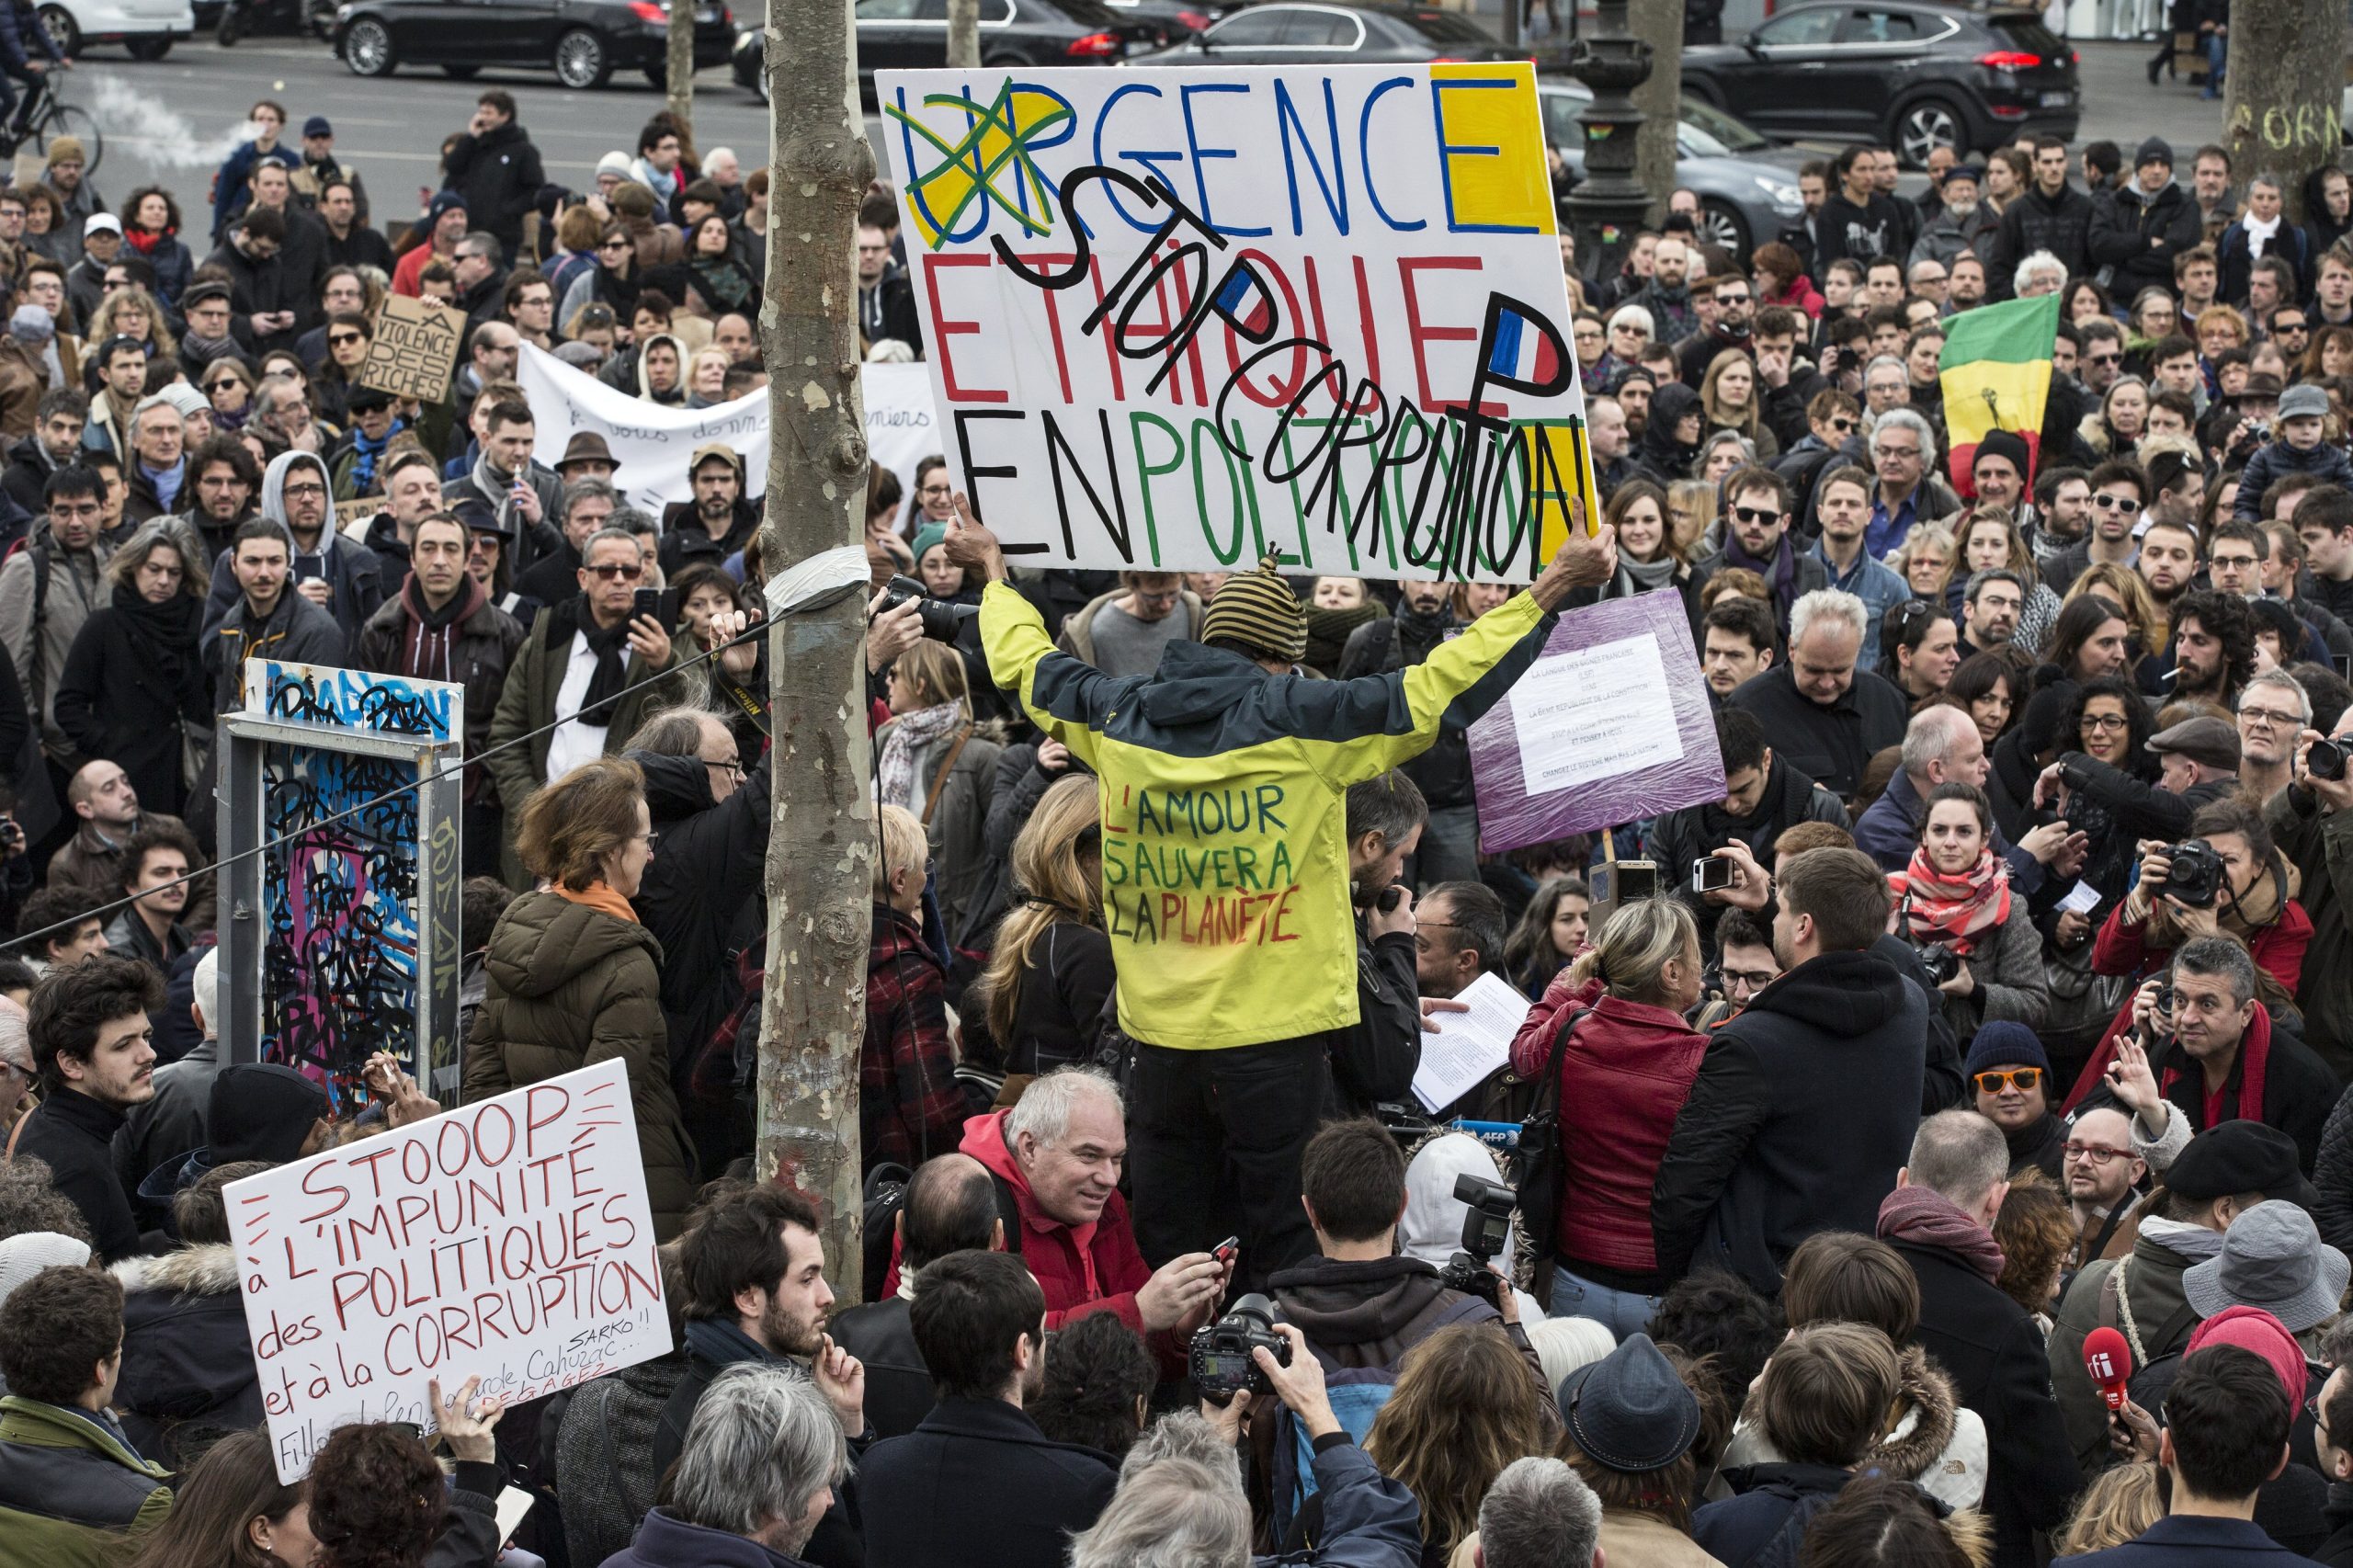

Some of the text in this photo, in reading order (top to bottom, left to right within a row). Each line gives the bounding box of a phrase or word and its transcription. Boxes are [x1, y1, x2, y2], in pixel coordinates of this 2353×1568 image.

[896, 77, 1540, 244] URGENCE
[990, 165, 1279, 397] STOP
[378, 319, 454, 358] VIOLENCE
[381, 298, 455, 335] LA
[363, 362, 442, 401] RICHES
[369, 341, 448, 378] DES
[953, 407, 1134, 564] EN
[735, 687, 761, 715] Nikon
[1106, 784, 1289, 839] L'AMOUR
[1105, 839, 1292, 891] SAUVERA
[1110, 884, 1302, 947] LA PLANÈTE
[300, 1085, 570, 1223] STOOOP
[1481, 1131, 1506, 1142] AFP
[257, 1309, 322, 1359] des
[266, 1366, 298, 1415] et
[336, 1341, 373, 1388] la
[2086, 1352, 2114, 1379] rfi
